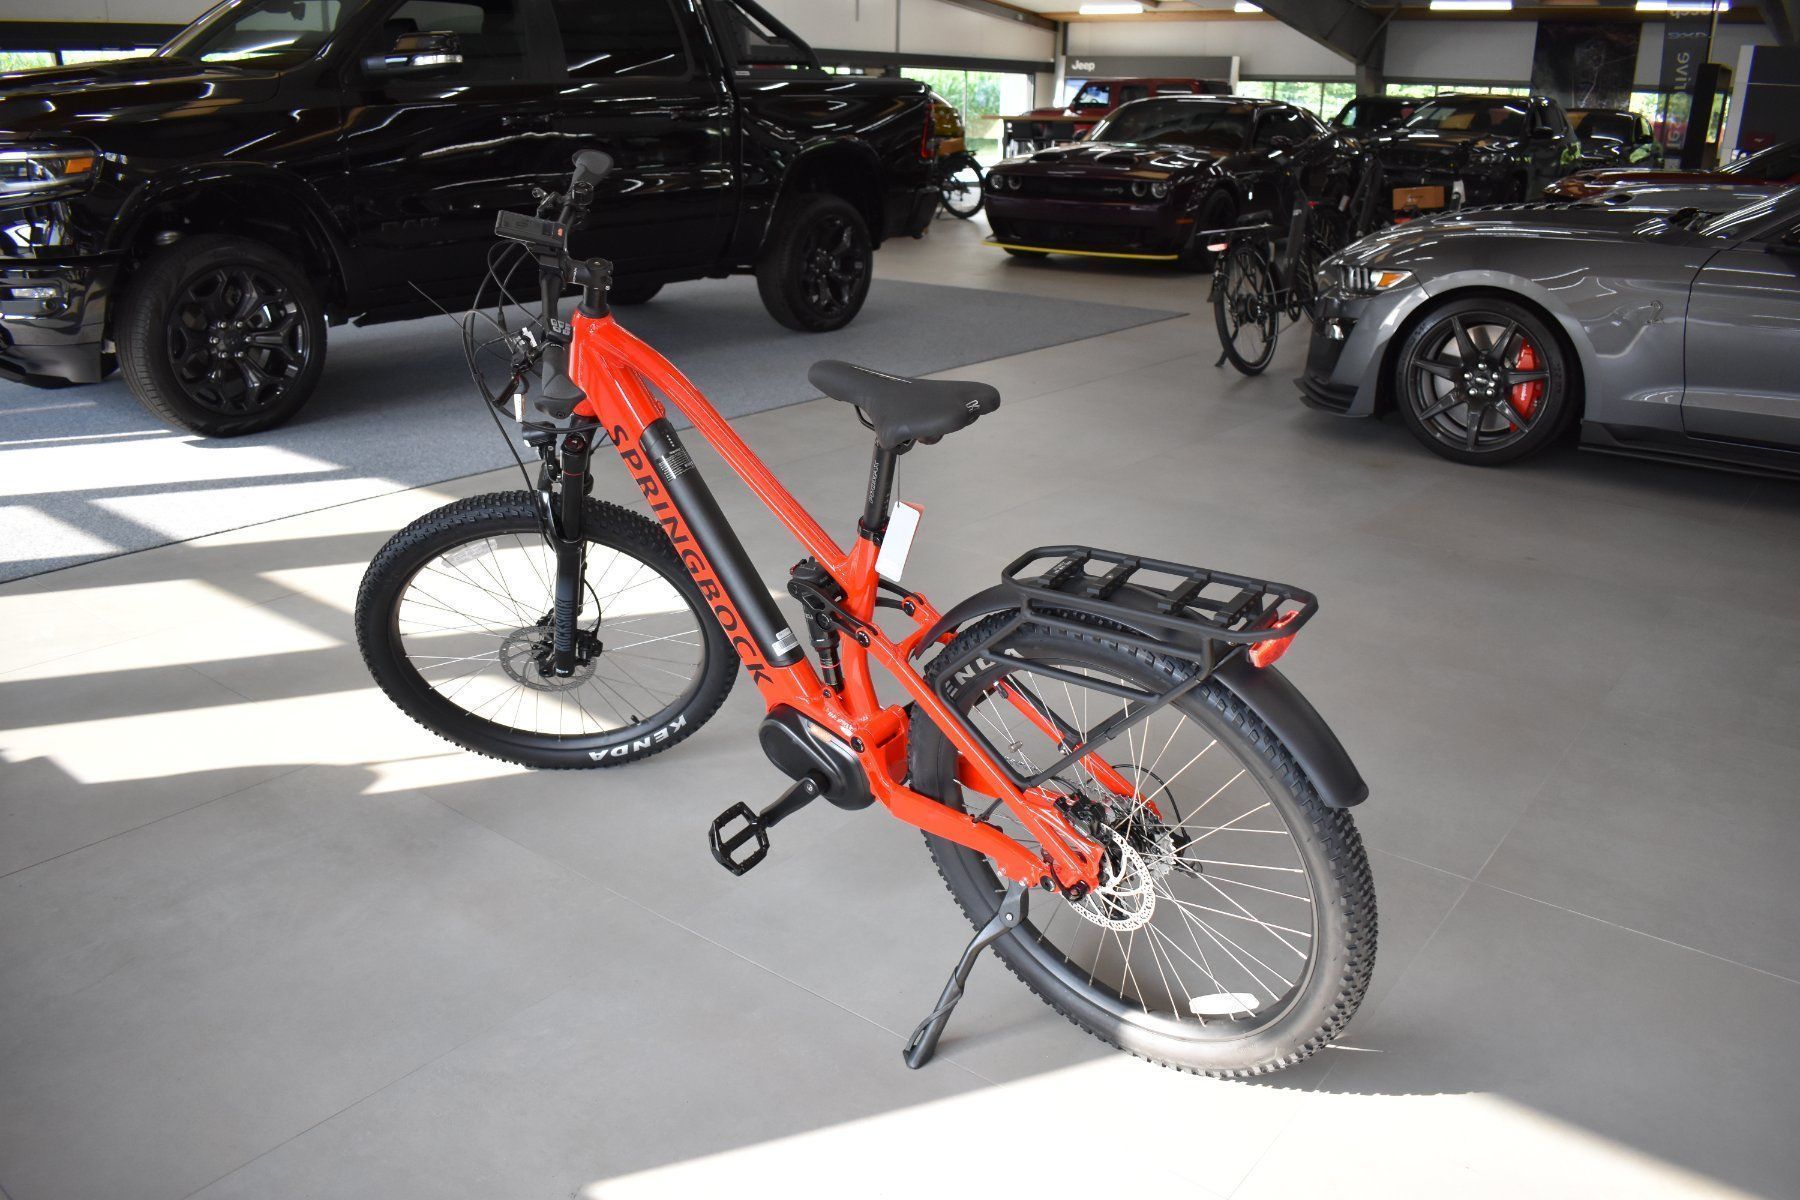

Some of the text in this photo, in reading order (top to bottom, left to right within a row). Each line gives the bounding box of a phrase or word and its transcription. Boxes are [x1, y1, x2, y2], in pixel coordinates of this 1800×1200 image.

[1071, 59, 1096, 72] Jeep
[611, 424, 774, 686] SPRINGBOCK
[554, 597, 573, 652] ROCKSHOX
[588, 714, 687, 762] KENDA
